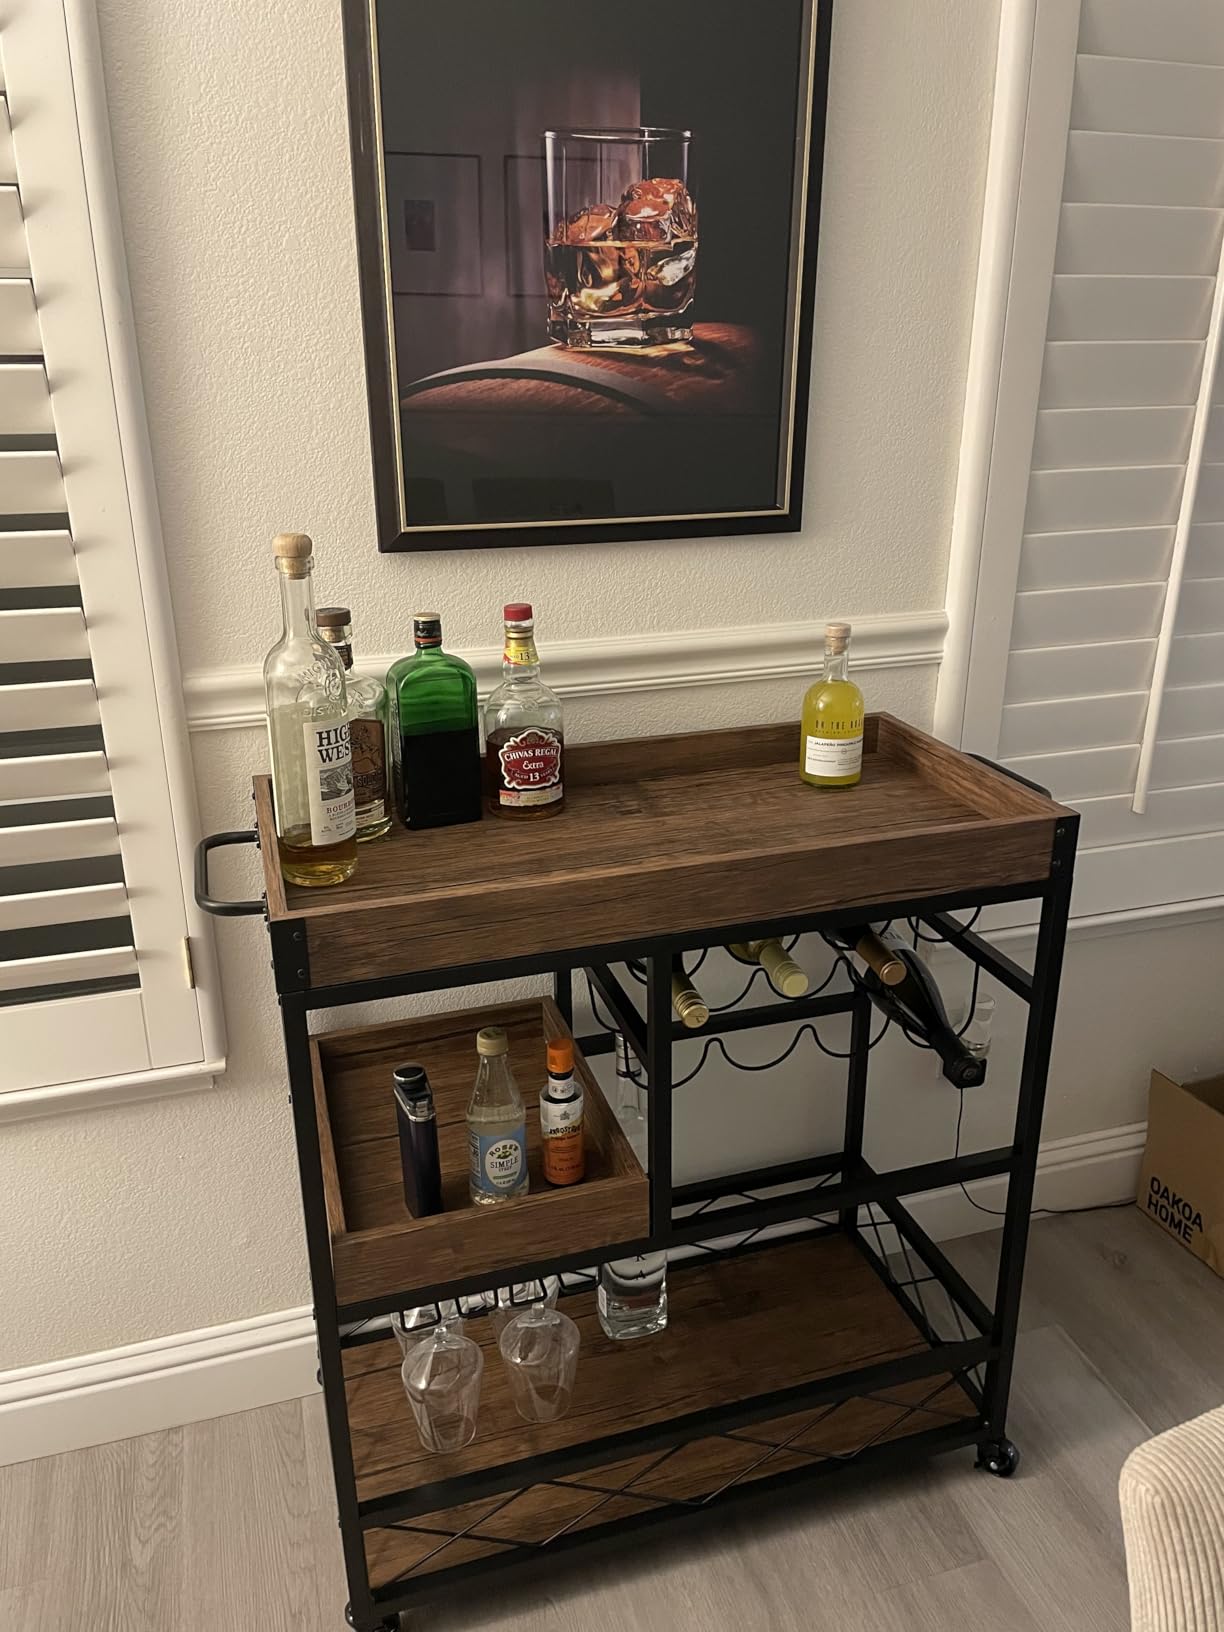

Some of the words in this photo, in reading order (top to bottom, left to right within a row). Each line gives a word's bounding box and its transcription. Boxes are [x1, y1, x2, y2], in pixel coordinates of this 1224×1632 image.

[520, 651, 530, 661] 13
[318, 741, 351, 763] WES
[504, 749, 534, 761] CHIVAS
[535, 748, 558, 757] REGAL
[522, 760, 544, 770] Extra
[529, 772, 540, 782] 13
[490, 1156, 519, 1169] SIMPLE
[1150, 1176, 1204, 1233] OAKOA
[1147, 1193, 1194, 1244] HOME
